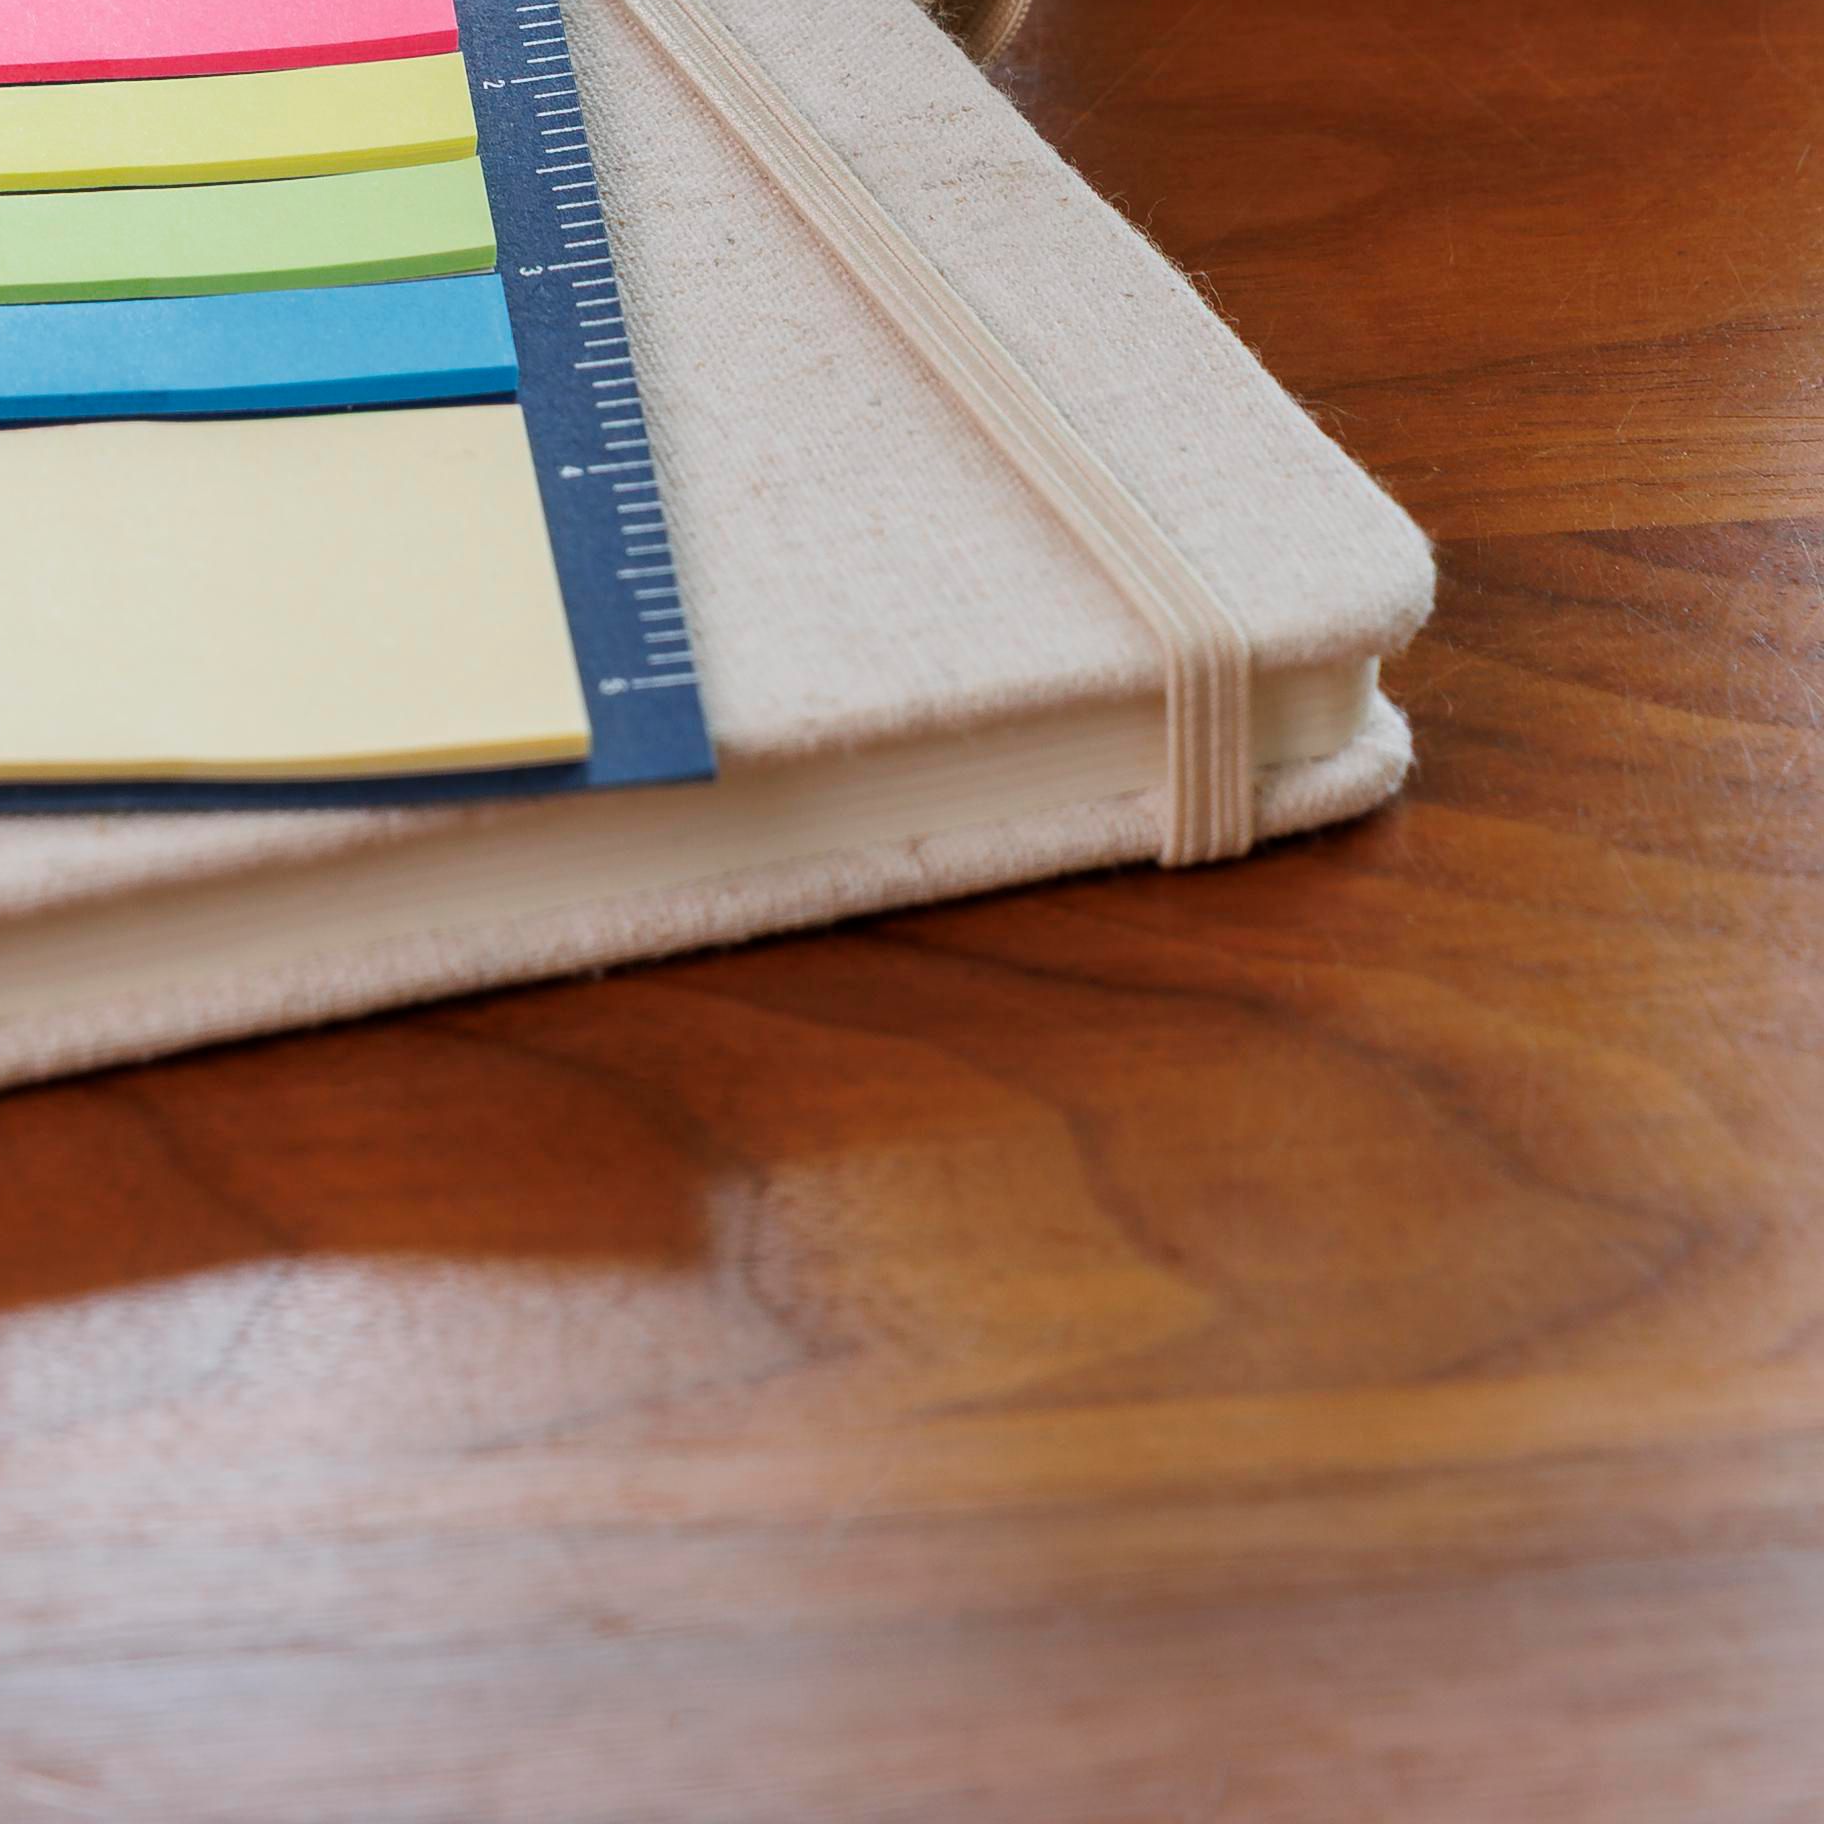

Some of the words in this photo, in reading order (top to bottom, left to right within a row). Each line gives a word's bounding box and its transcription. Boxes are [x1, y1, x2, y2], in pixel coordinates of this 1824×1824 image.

[481, 78, 507, 91] 2
[518, 264, 544, 278] 3
[559, 464, 585, 479] 4
